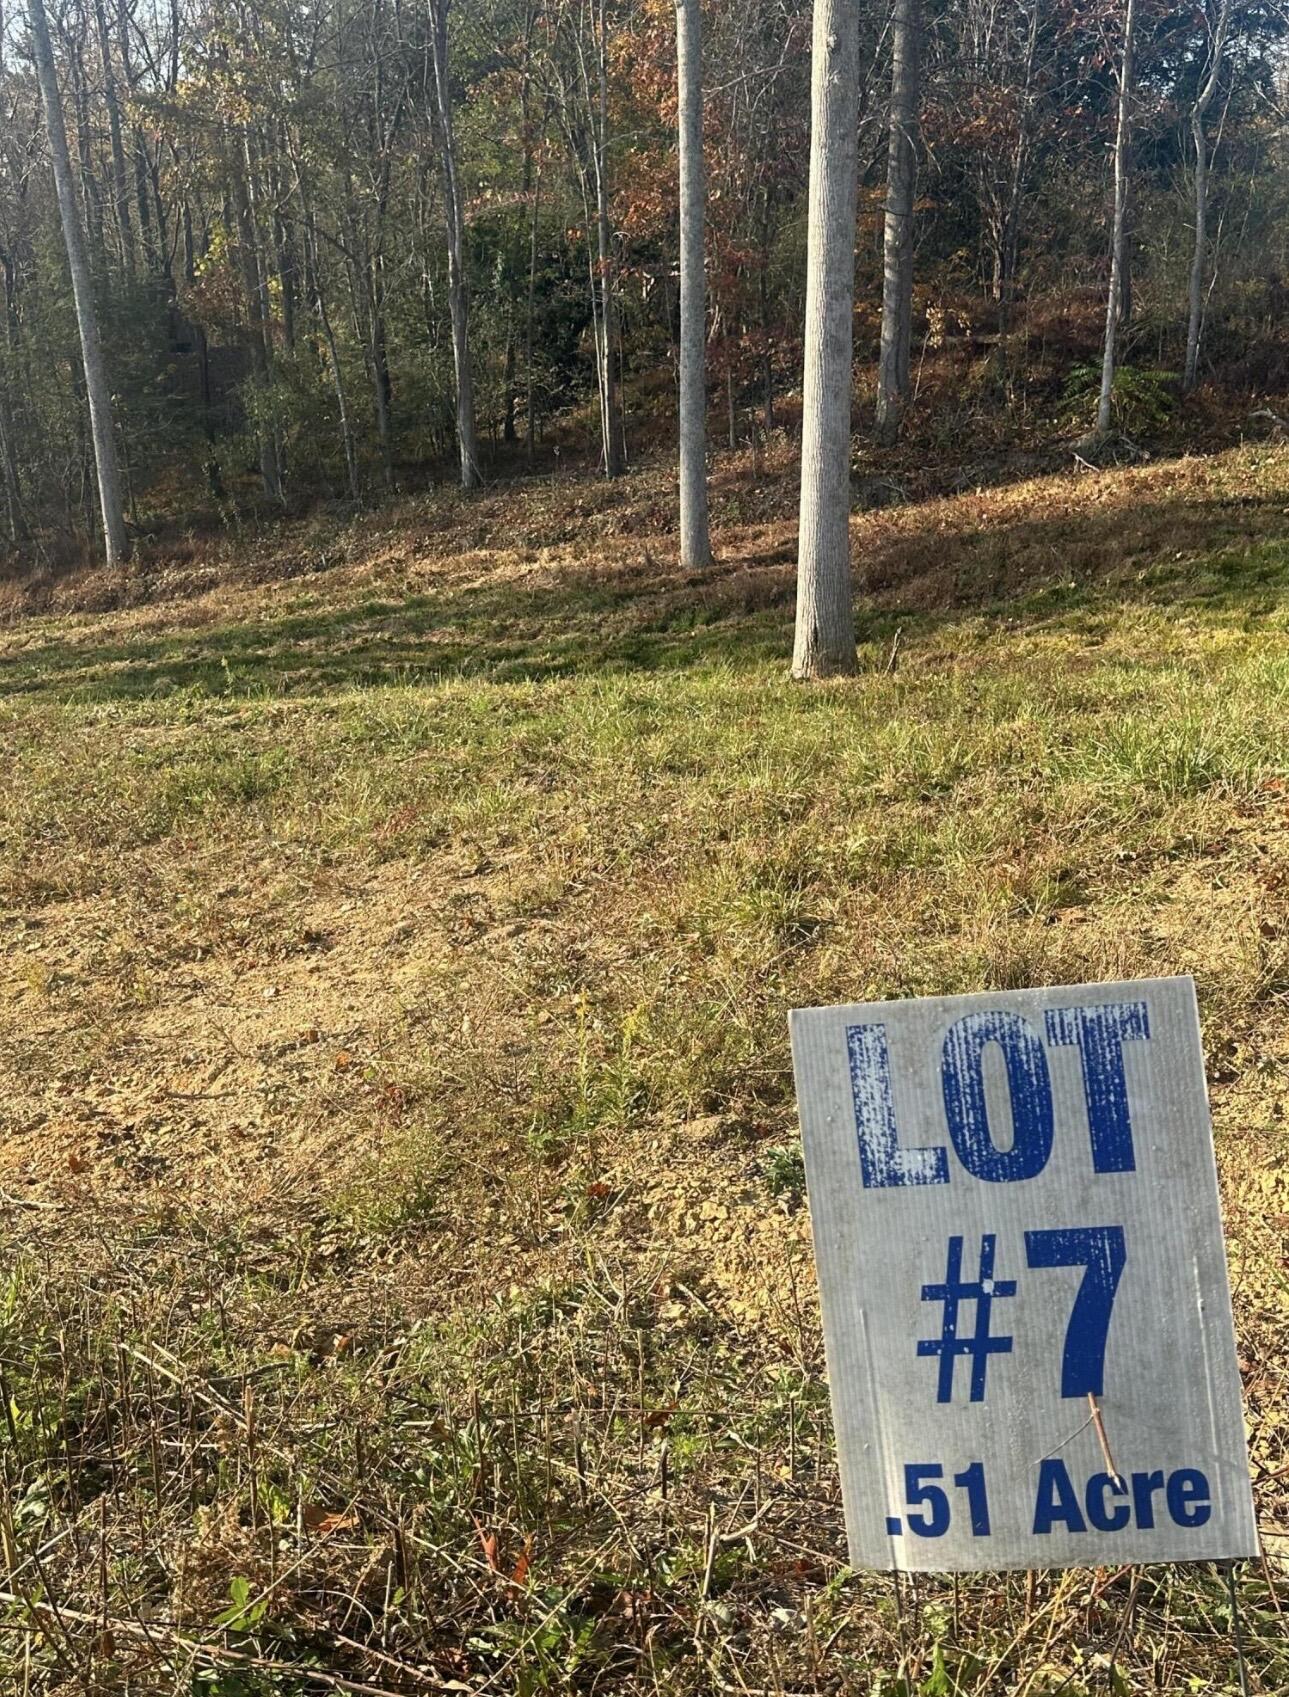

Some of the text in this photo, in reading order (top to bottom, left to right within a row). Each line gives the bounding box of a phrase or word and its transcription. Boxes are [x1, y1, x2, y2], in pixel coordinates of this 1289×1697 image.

[846, 1002, 1151, 1189] LOT
[916, 1225, 1127, 1404] #7
[886, 1458, 1213, 1538] .51 Acre
